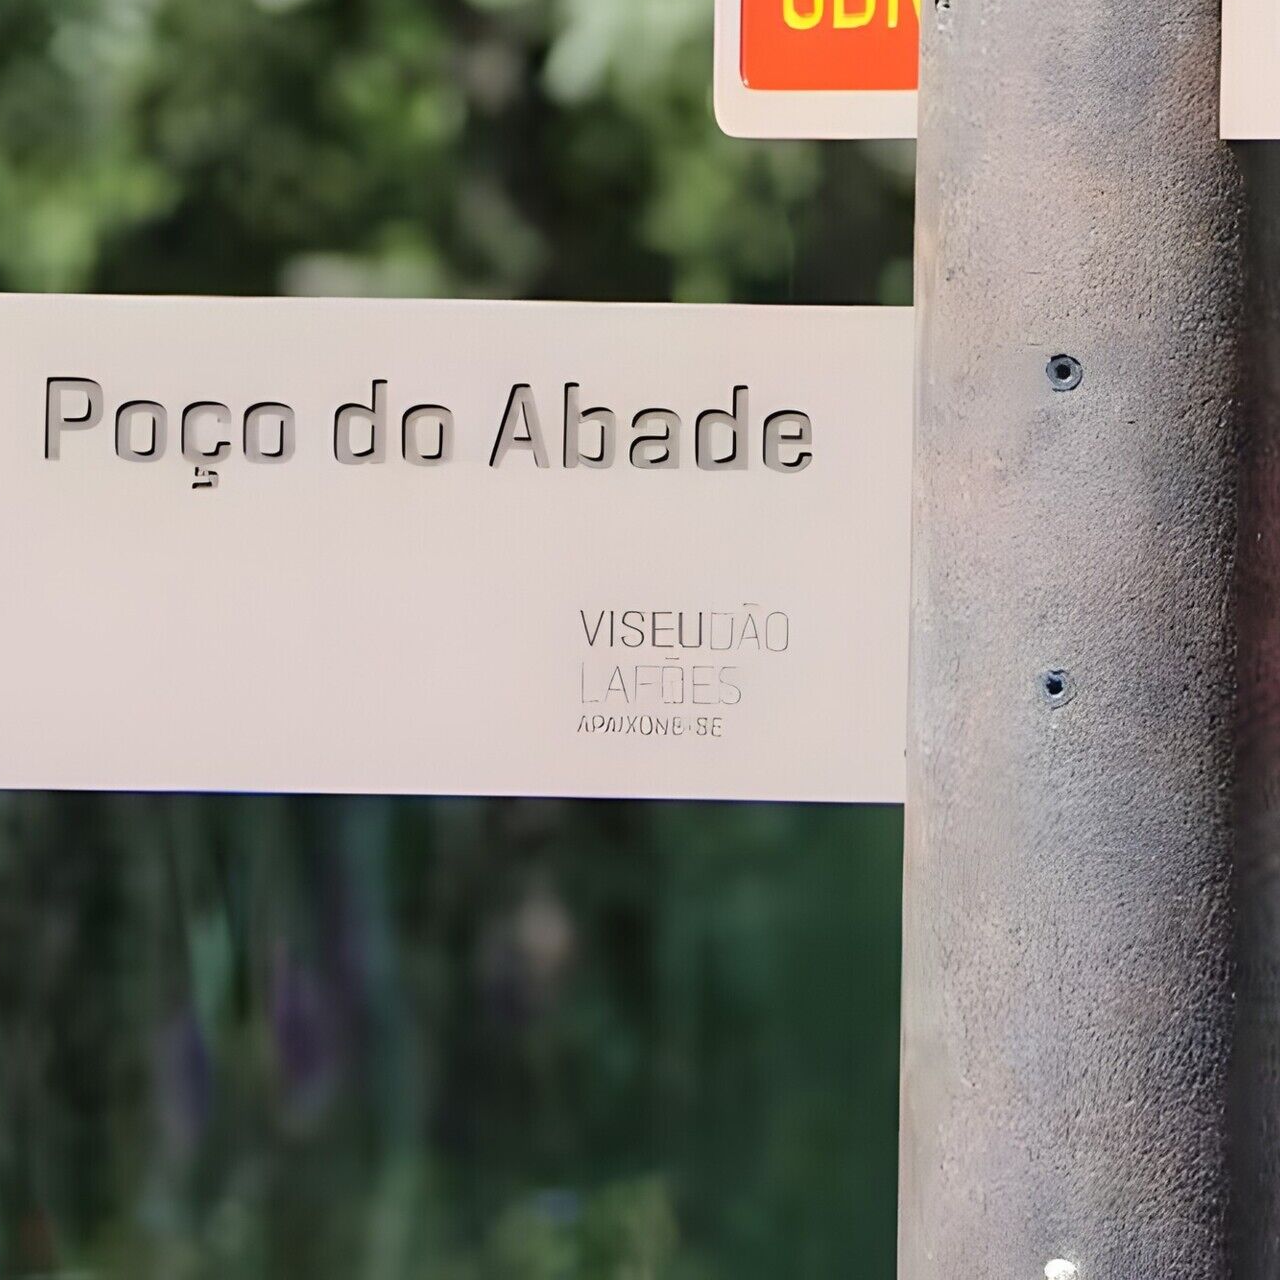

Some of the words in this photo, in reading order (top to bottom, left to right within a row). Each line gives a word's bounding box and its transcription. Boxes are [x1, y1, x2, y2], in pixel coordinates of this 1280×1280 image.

[43, 376, 297, 490] Poço
[332, 378, 455, 468] do
[487, 381, 814, 475] Abade
[580, 656, 742, 705] LAFÕES
